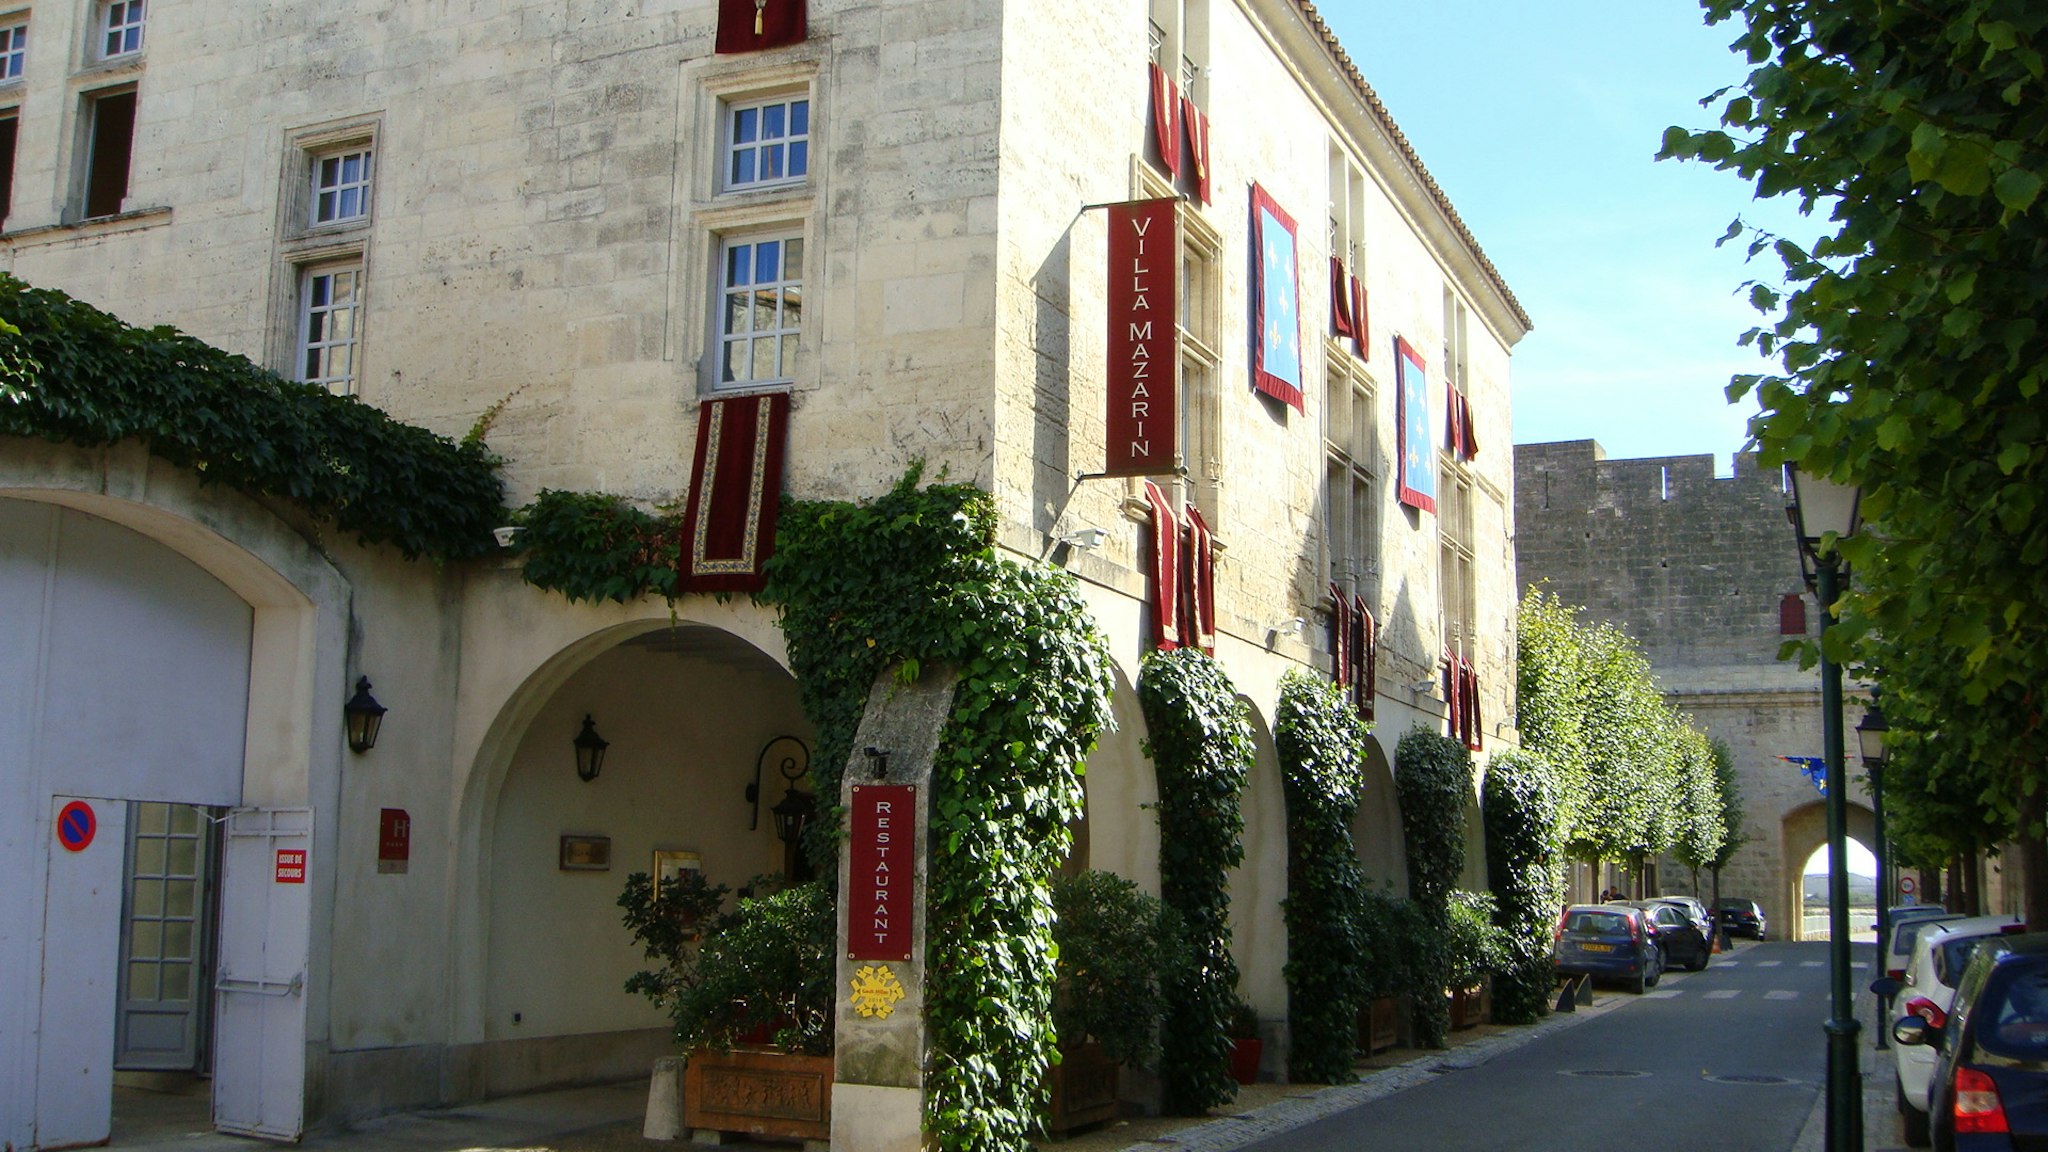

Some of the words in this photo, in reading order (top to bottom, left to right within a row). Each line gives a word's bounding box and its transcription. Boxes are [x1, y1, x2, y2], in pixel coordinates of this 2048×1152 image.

[1131, 217, 1151, 311] VILLA
[1129, 321, 1152, 458] MAZARIN
[394, 819, 406, 838] H
[277, 868, 302, 878] SECOURS
[278, 854, 294, 864] ISSUE
[295, 854, 302, 864] DE
[874, 801, 892, 944] RESTAURANT
